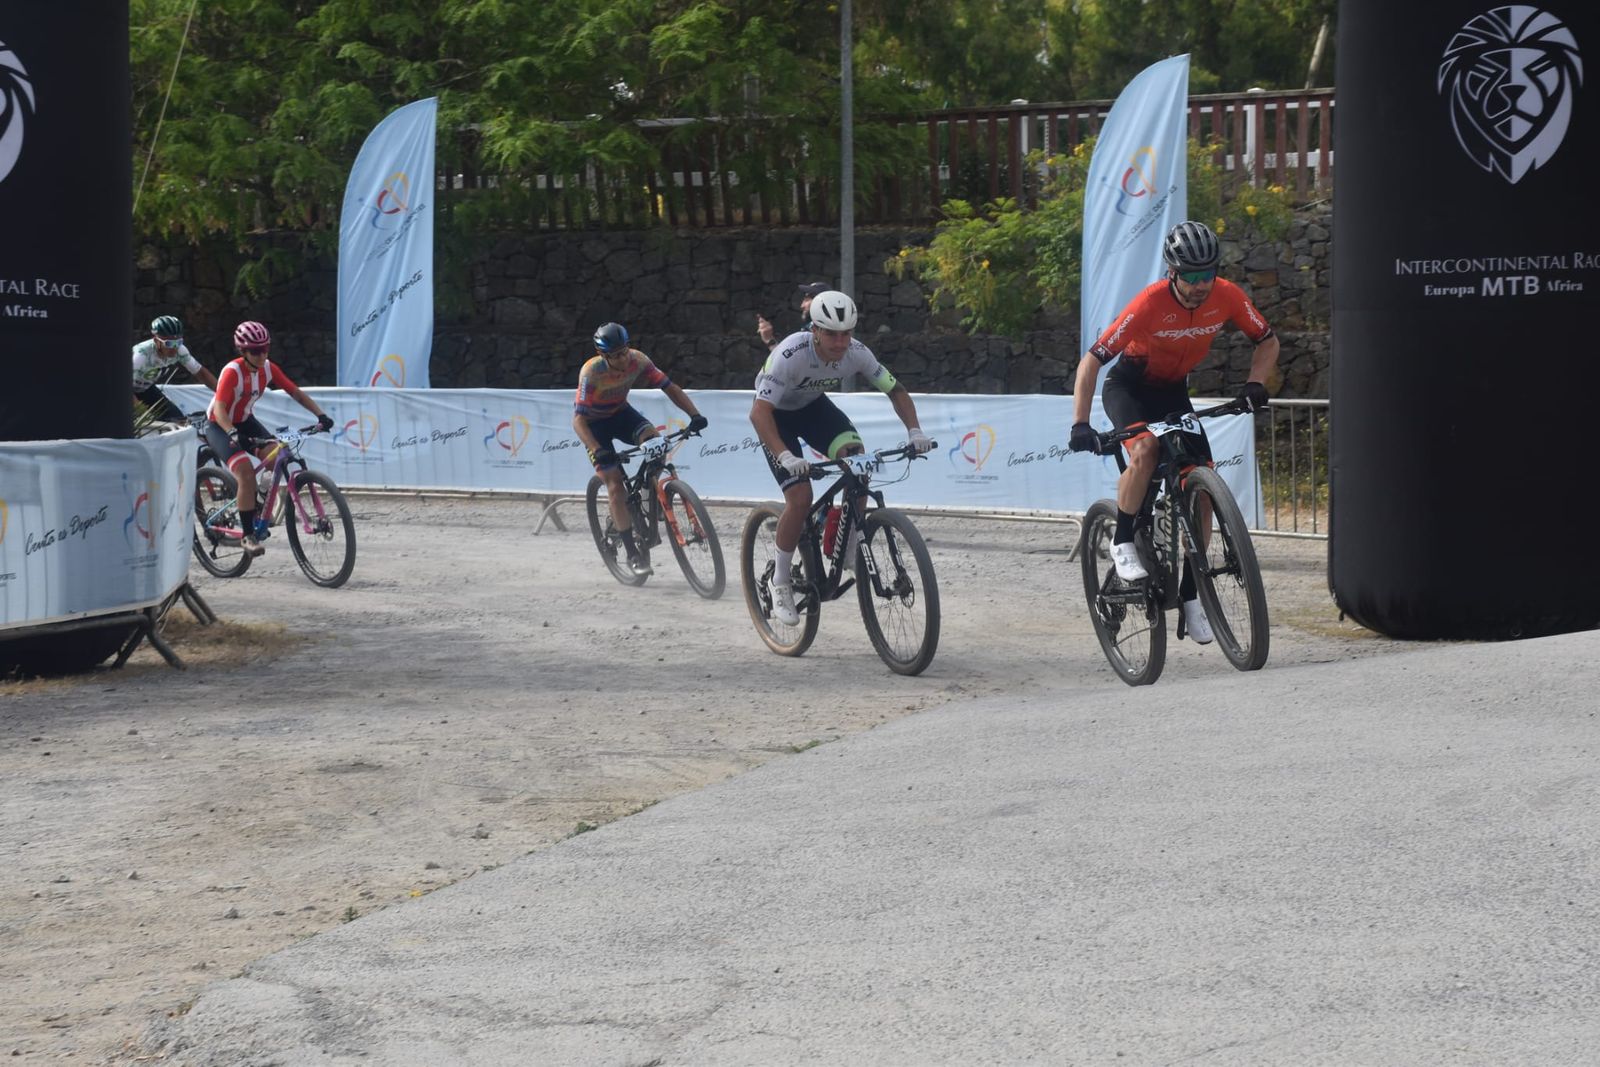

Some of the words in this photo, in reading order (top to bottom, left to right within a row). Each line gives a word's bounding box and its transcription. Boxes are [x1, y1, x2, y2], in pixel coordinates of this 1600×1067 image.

[1424, 284, 1475, 297] Europa
[1481, 276, 1540, 297] MTB
[1546, 279, 1583, 291] Africa
[2, 304, 48, 319] Africa
[431, 425, 469, 445] Deporte
[648, 442, 669, 459] 232
[855, 460, 880, 473] 147
[69, 504, 108, 540] Deporte
